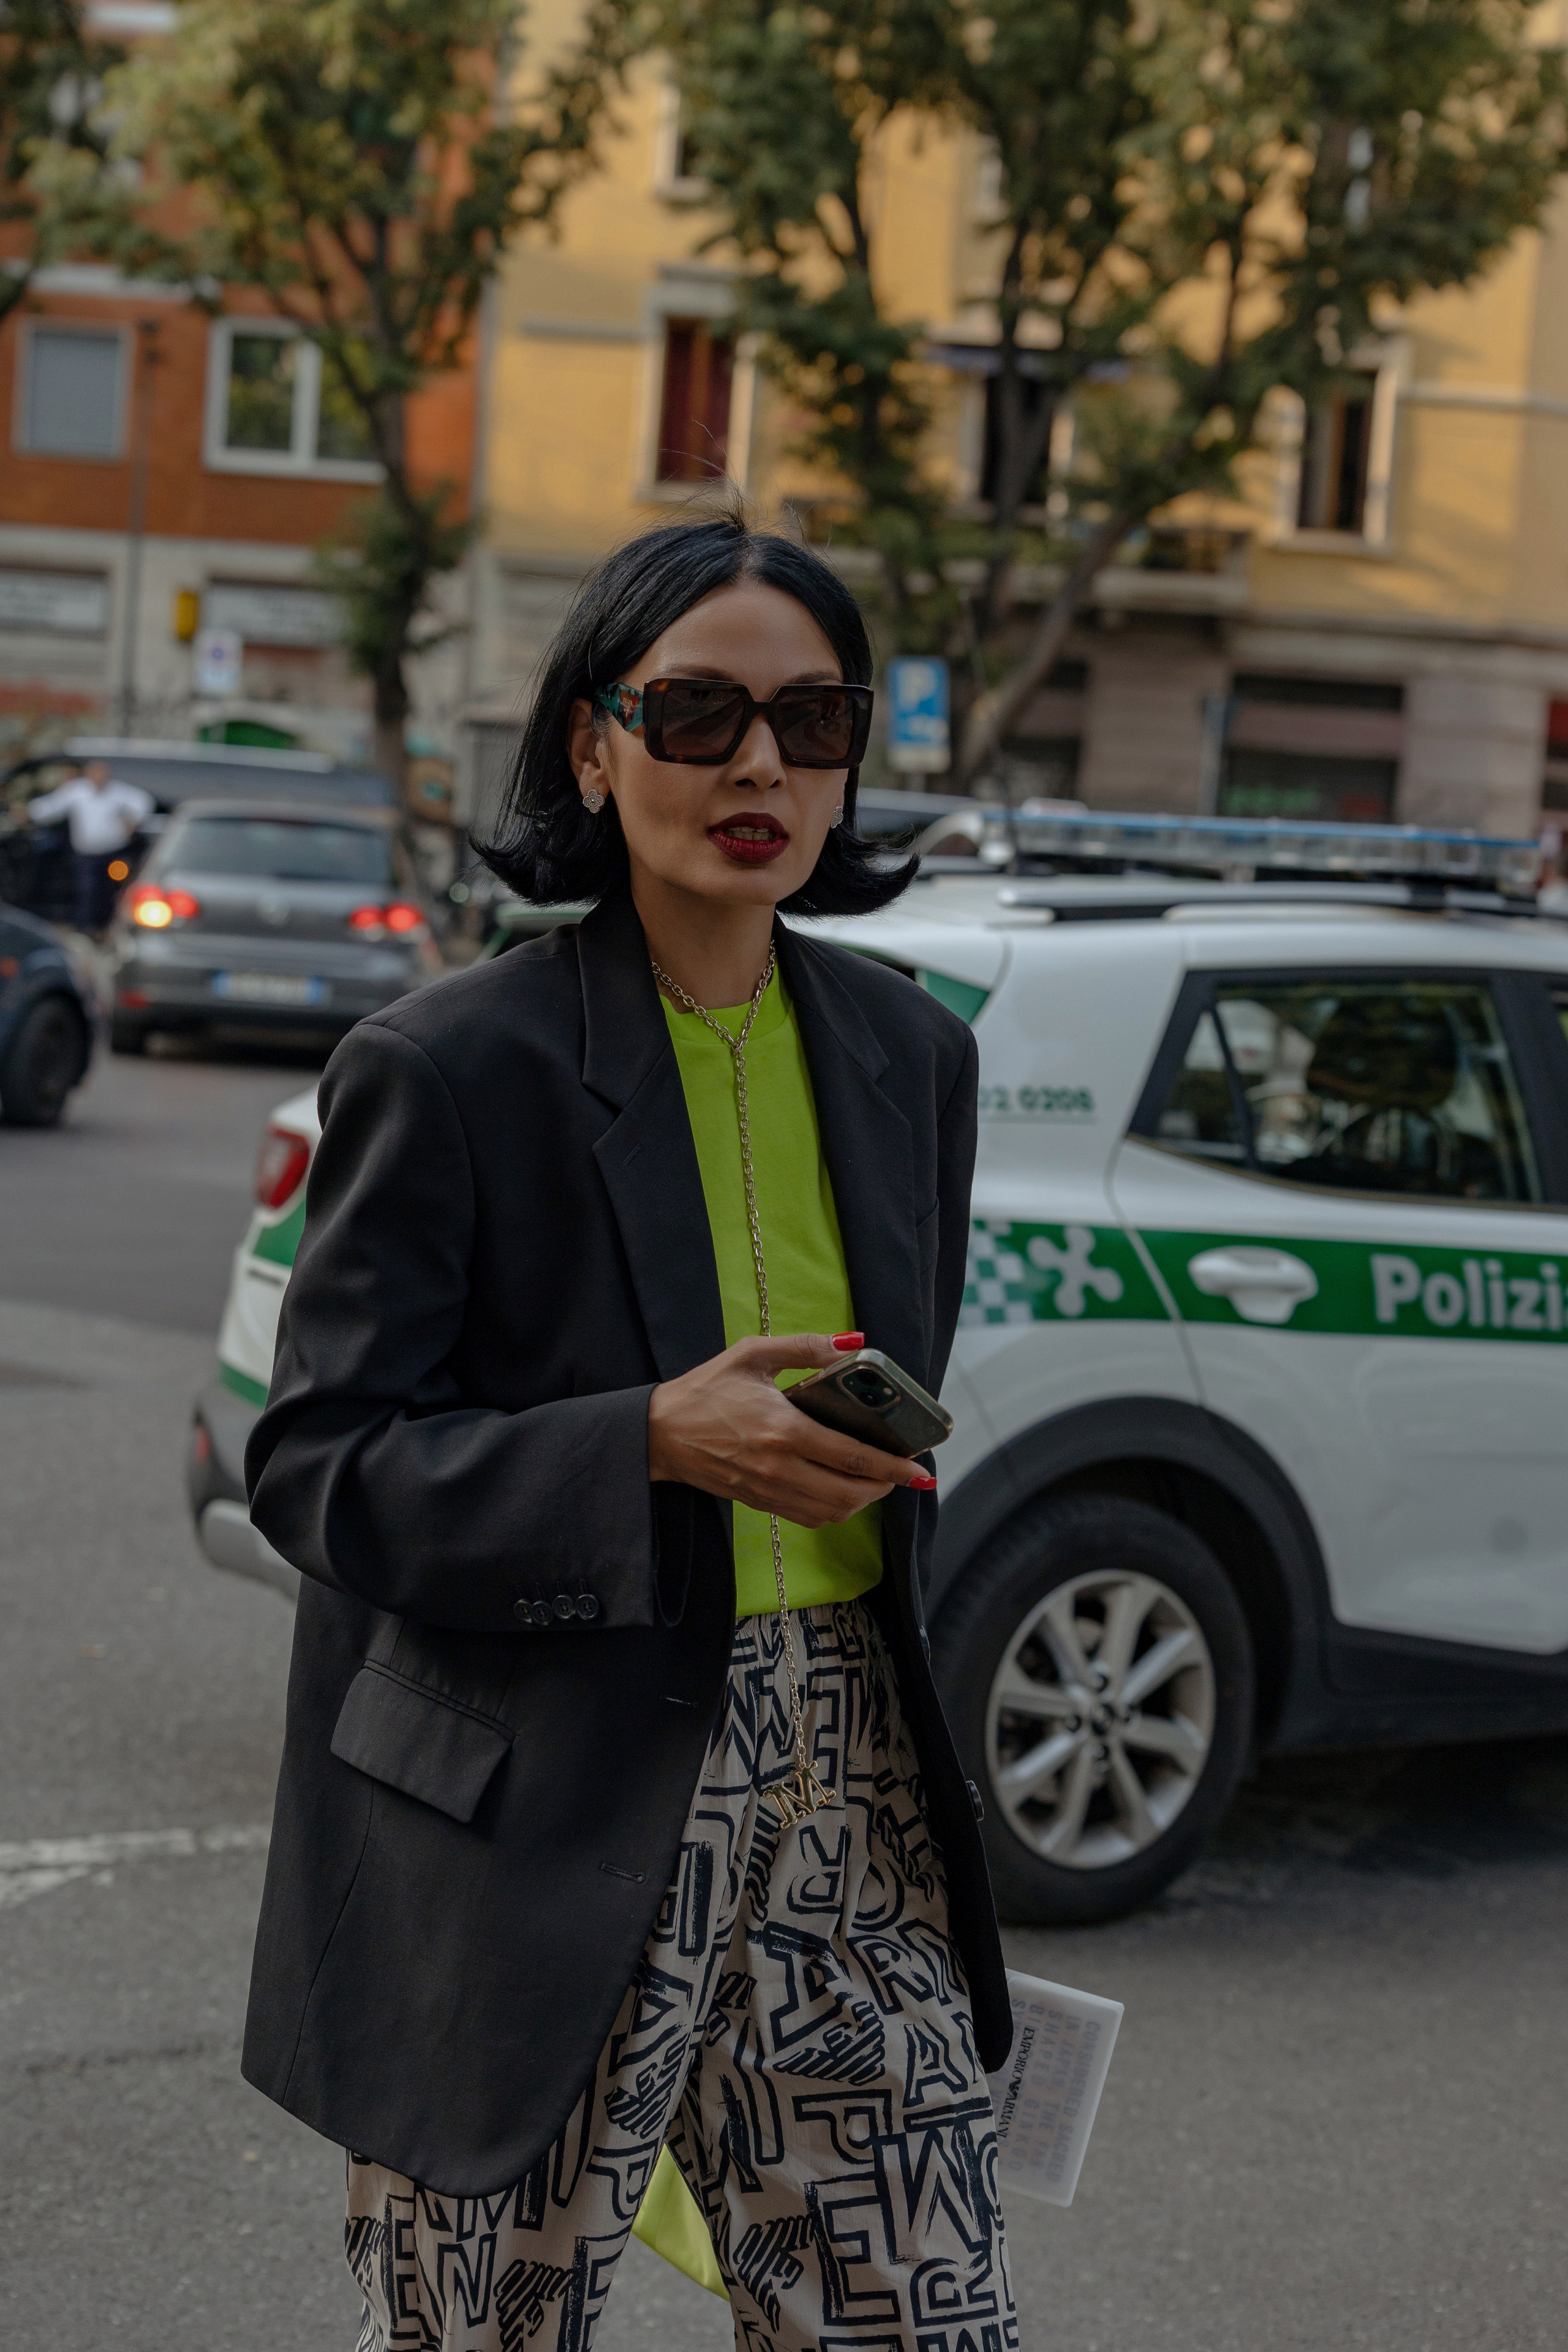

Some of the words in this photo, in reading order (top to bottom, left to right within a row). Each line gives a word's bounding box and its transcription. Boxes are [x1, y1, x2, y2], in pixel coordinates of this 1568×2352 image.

[1370, 1253, 1568, 1332] Polizi
[1011, 2027, 1035, 2081] EMPORIO
[996, 2092, 1018, 2138] ARMANI
